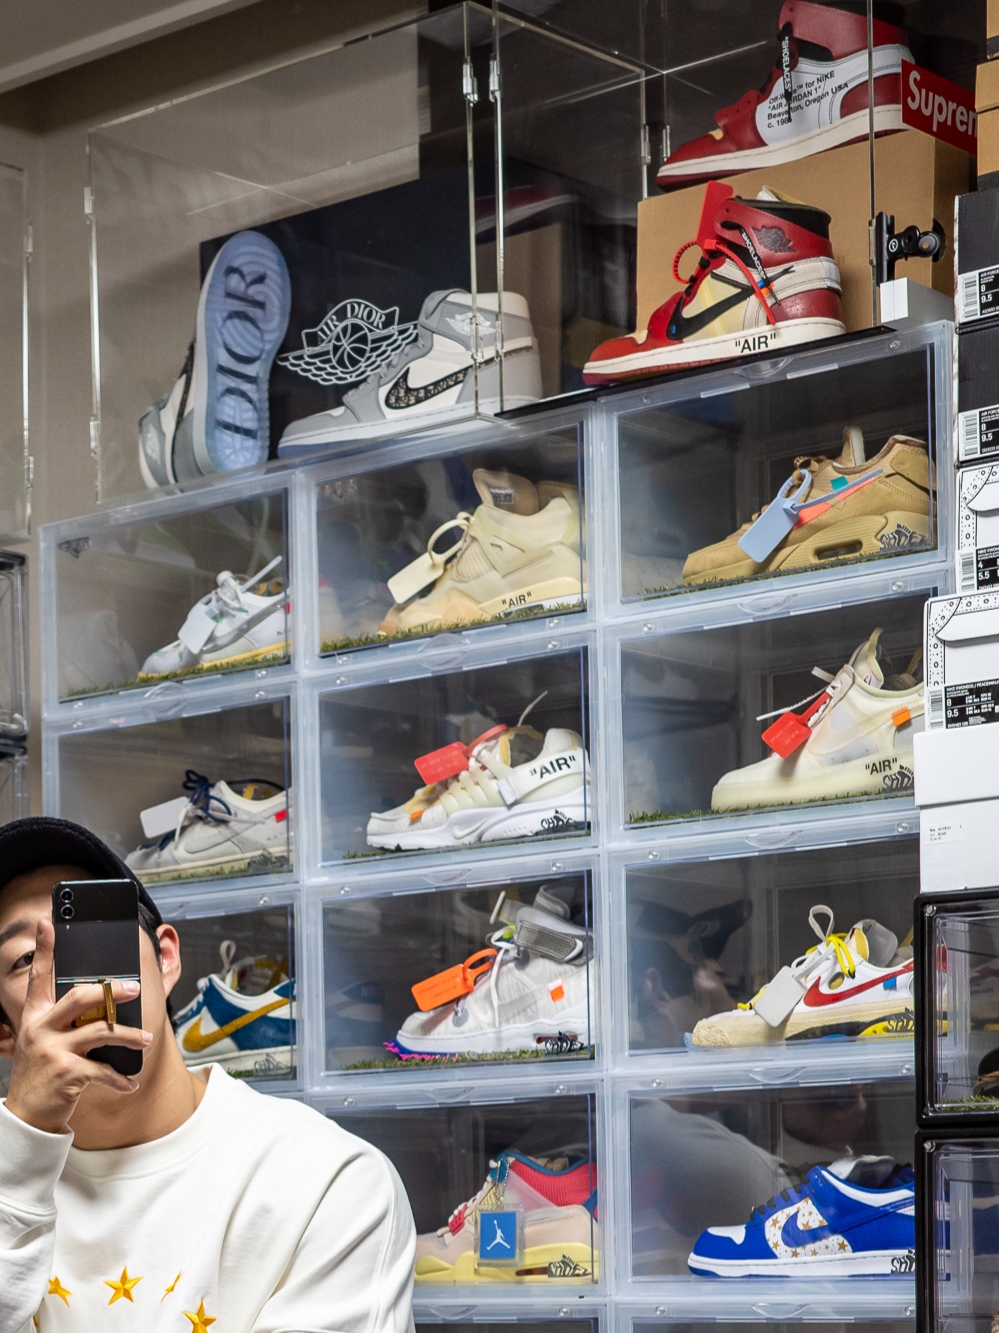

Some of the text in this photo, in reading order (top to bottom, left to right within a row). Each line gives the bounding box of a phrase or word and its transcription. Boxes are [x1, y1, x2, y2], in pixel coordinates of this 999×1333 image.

[804, 80, 815, 89] for
[816, 70, 836, 84] NIKE
[804, 91, 830, 108] Oregon
[831, 82, 849, 94] USA
[981, 294, 993, 304] 9.5
[347, 303, 386, 330] DIOR
[735, 332, 777, 353] "AIR"
[214, 265, 267, 440] DIOR
[981, 423, 986, 431] 8
[981, 433, 993, 442] 9.5
[978, 571, 990, 580] 5.5
[502, 591, 532, 608] "AIR"
[947, 698, 952, 706] 8
[947, 709, 959, 718] 9.5
[530, 755, 576, 780] "AIR"
[865, 758, 898, 775] "AIR"
